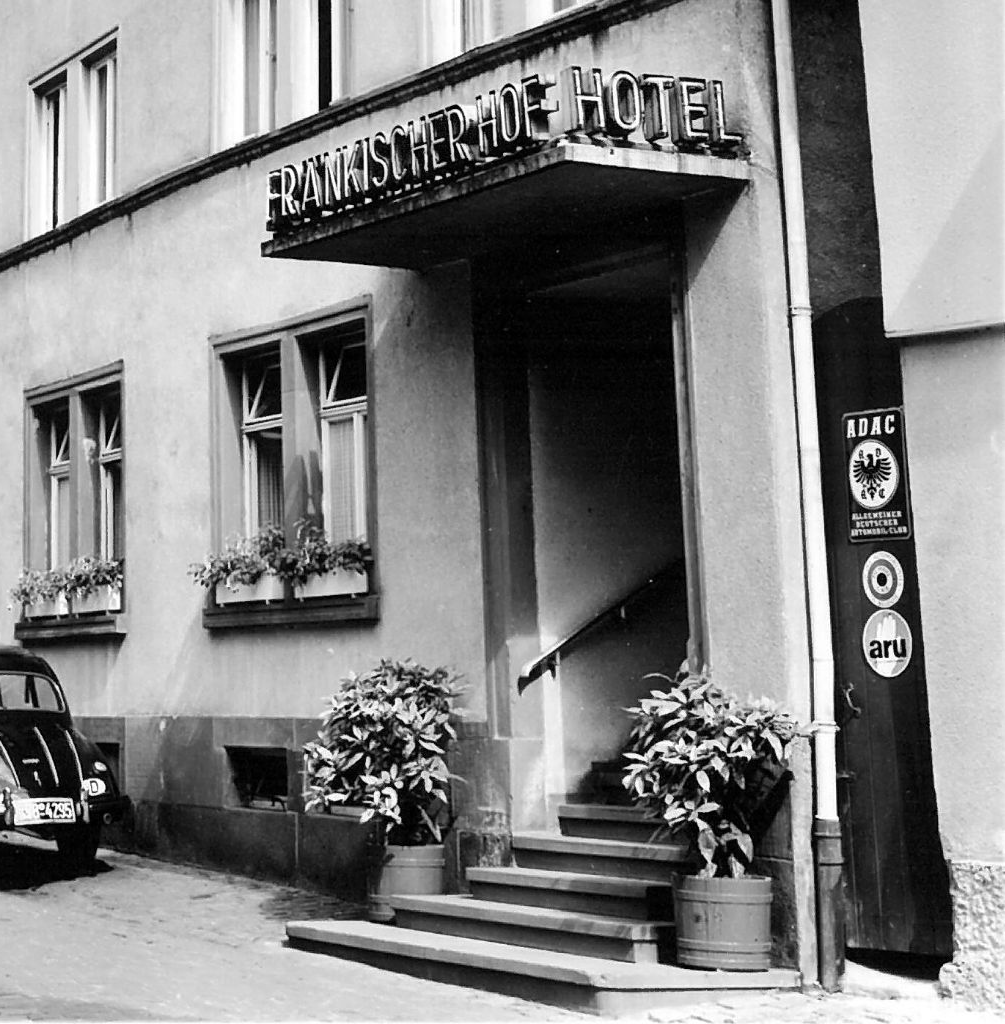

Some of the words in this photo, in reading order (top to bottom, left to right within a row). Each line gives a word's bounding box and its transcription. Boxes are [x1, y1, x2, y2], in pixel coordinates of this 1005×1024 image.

[474, 73, 549, 156] HOF
[567, 65, 744, 146] HOTEL
[846, 414, 896, 439] ADAC
[855, 518, 899, 528] DEUTSCHER
[869, 638, 907, 659] aru
[89, 780, 99, 794] D
